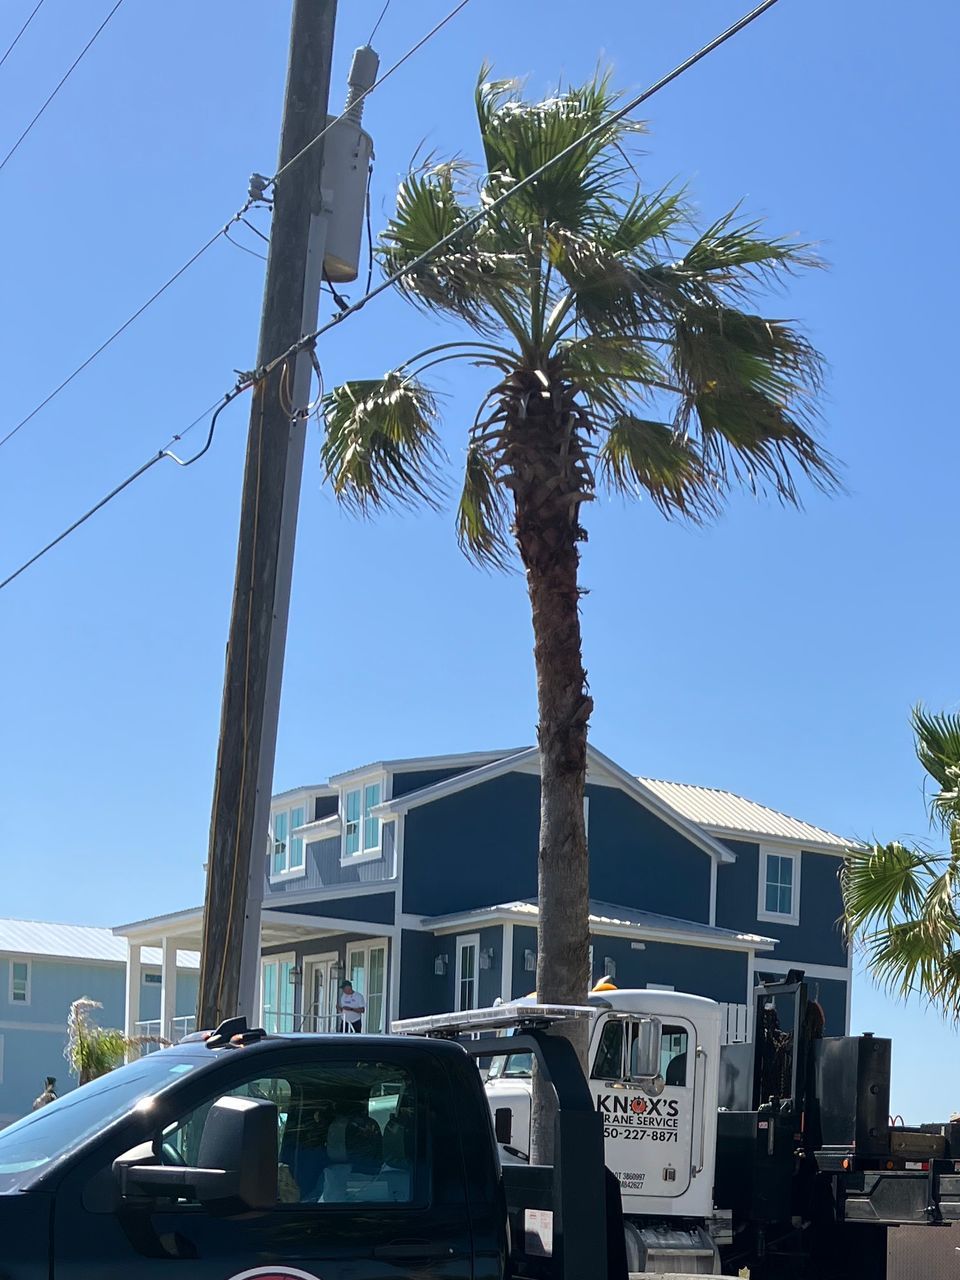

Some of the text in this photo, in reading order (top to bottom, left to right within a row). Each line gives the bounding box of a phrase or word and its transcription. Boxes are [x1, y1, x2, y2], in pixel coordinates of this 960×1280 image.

[597, 1095, 679, 1117] KNOX'S
[604, 1114, 679, 1128] RANE SERVICE
[603, 1127, 678, 1142] 50-227-8871
